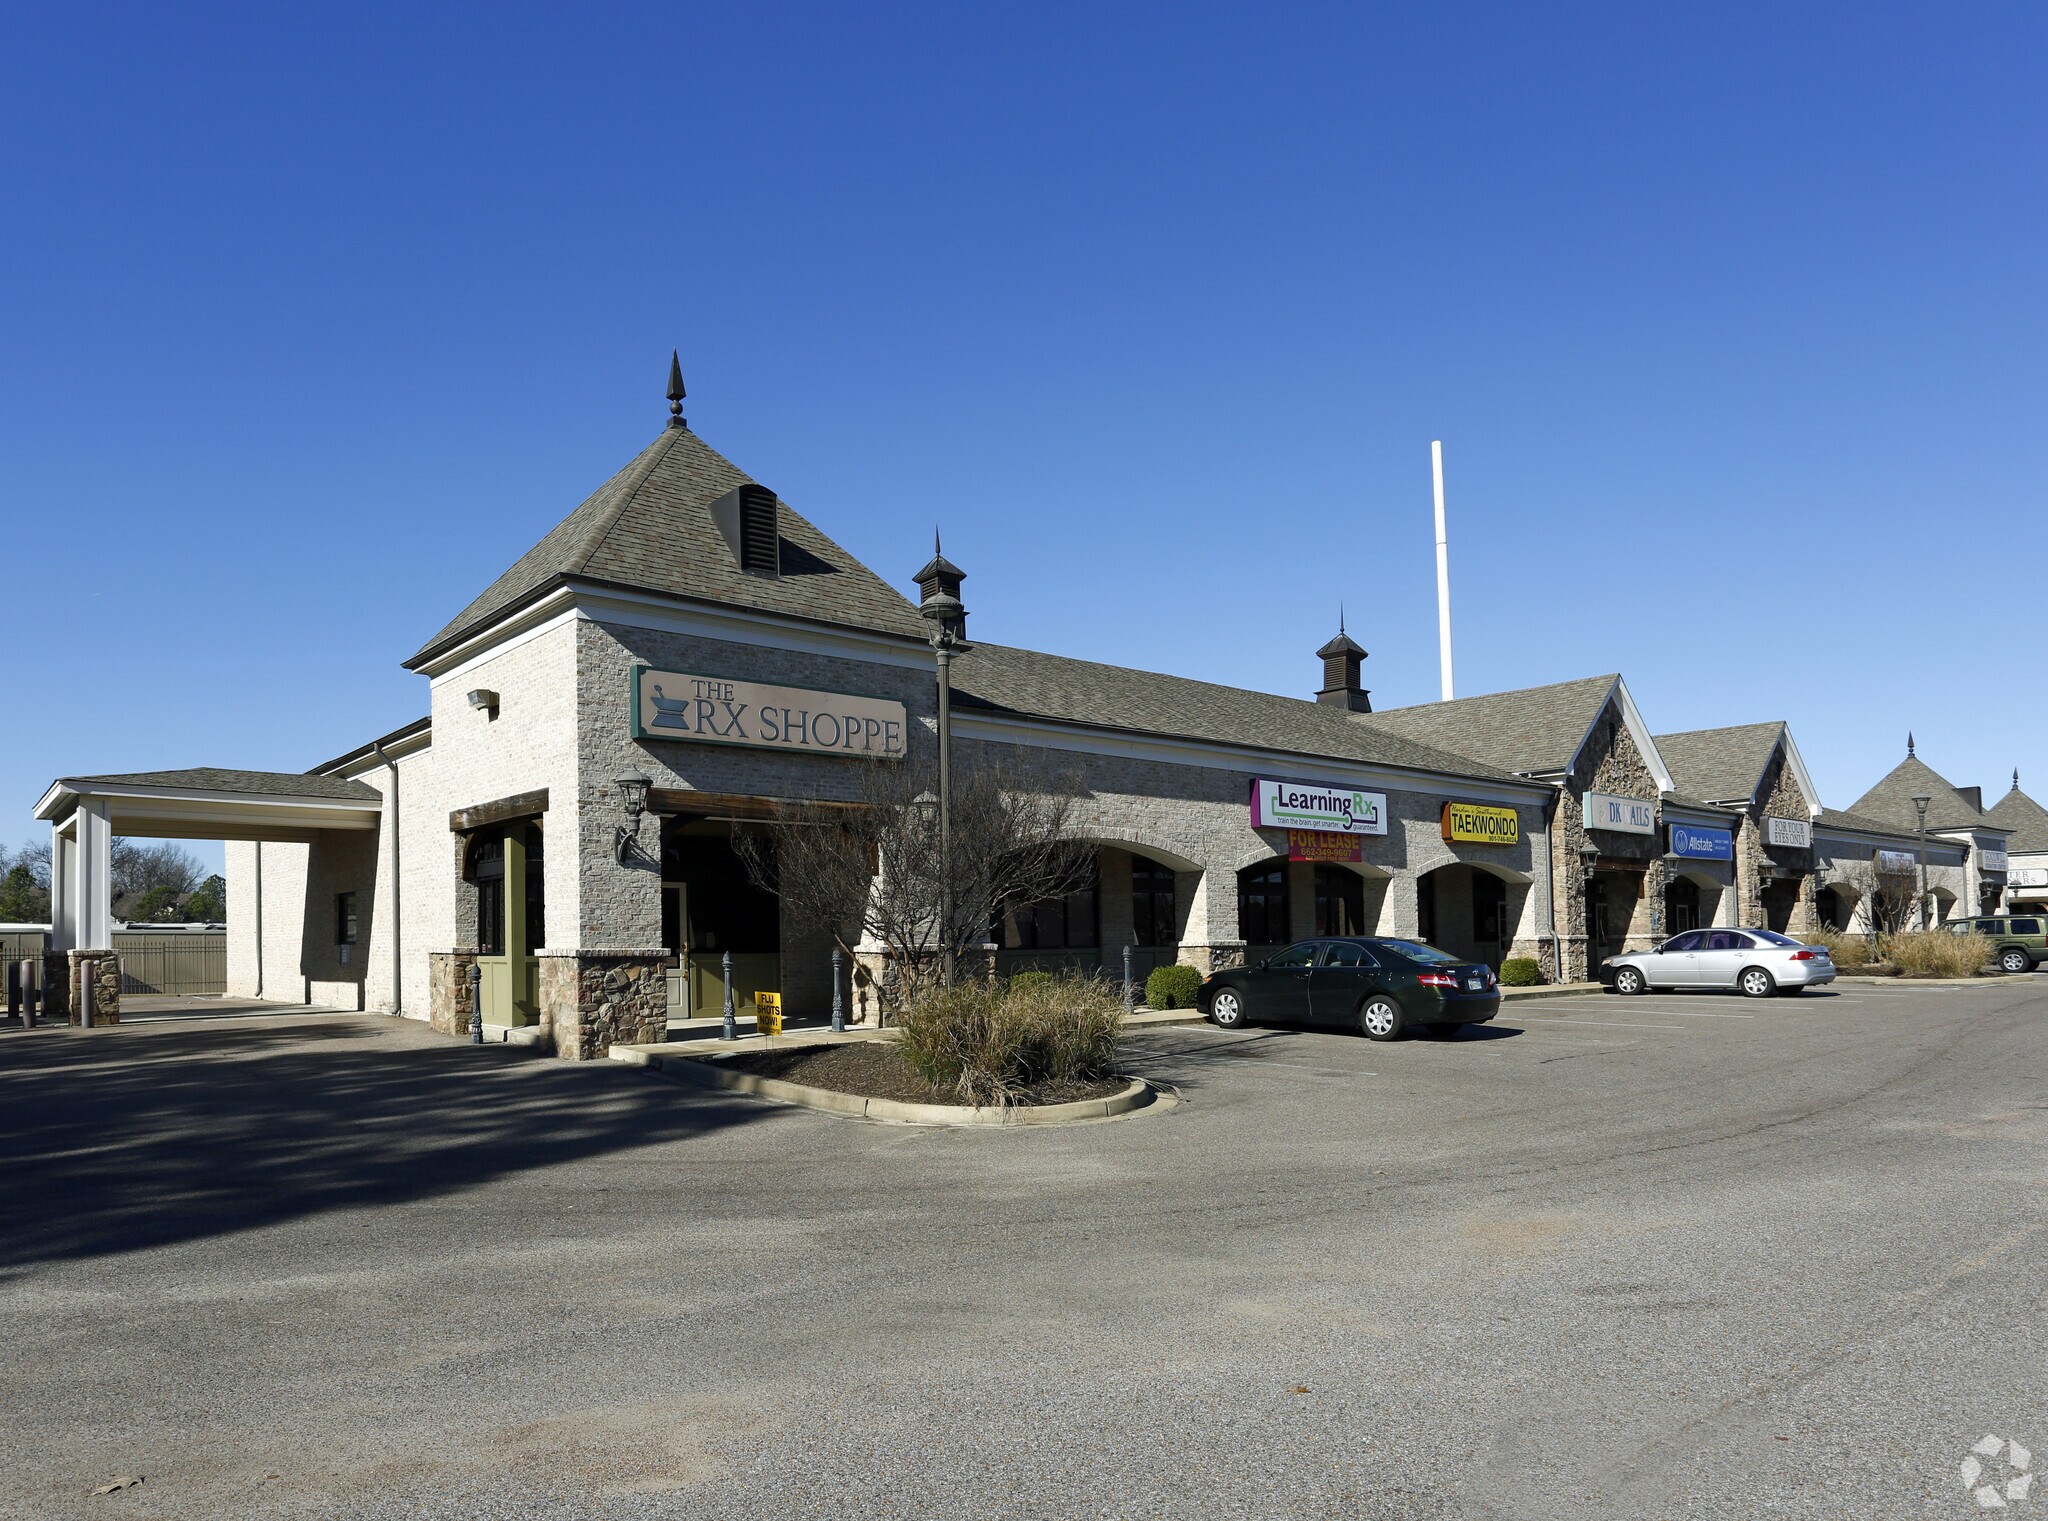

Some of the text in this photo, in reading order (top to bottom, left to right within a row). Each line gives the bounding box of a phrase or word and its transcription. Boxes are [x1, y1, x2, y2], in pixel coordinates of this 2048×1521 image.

[690, 679, 735, 702] THE
[693, 699, 903, 754] RX SHOPPE
[1609, 802, 1621, 823] DK
[1278, 816, 1289, 825] train
[1290, 817, 1299, 825] the
[1312, 820, 1321, 828] get
[1452, 813, 1516, 835] TAEKWONDO
[1775, 821, 1804, 834] FOR YOUR
[1289, 830, 1360, 850] FOR LEASE
[1688, 836, 1713, 852] Allstate
[1775, 832, 1805, 845] EYES ONLY
[1301, 848, 1352, 857] 662-349-9607
[761, 994, 774, 1004] FLU
[757, 1004, 780, 1016] SHOTS
[760, 1016, 778, 1026] NOW!
